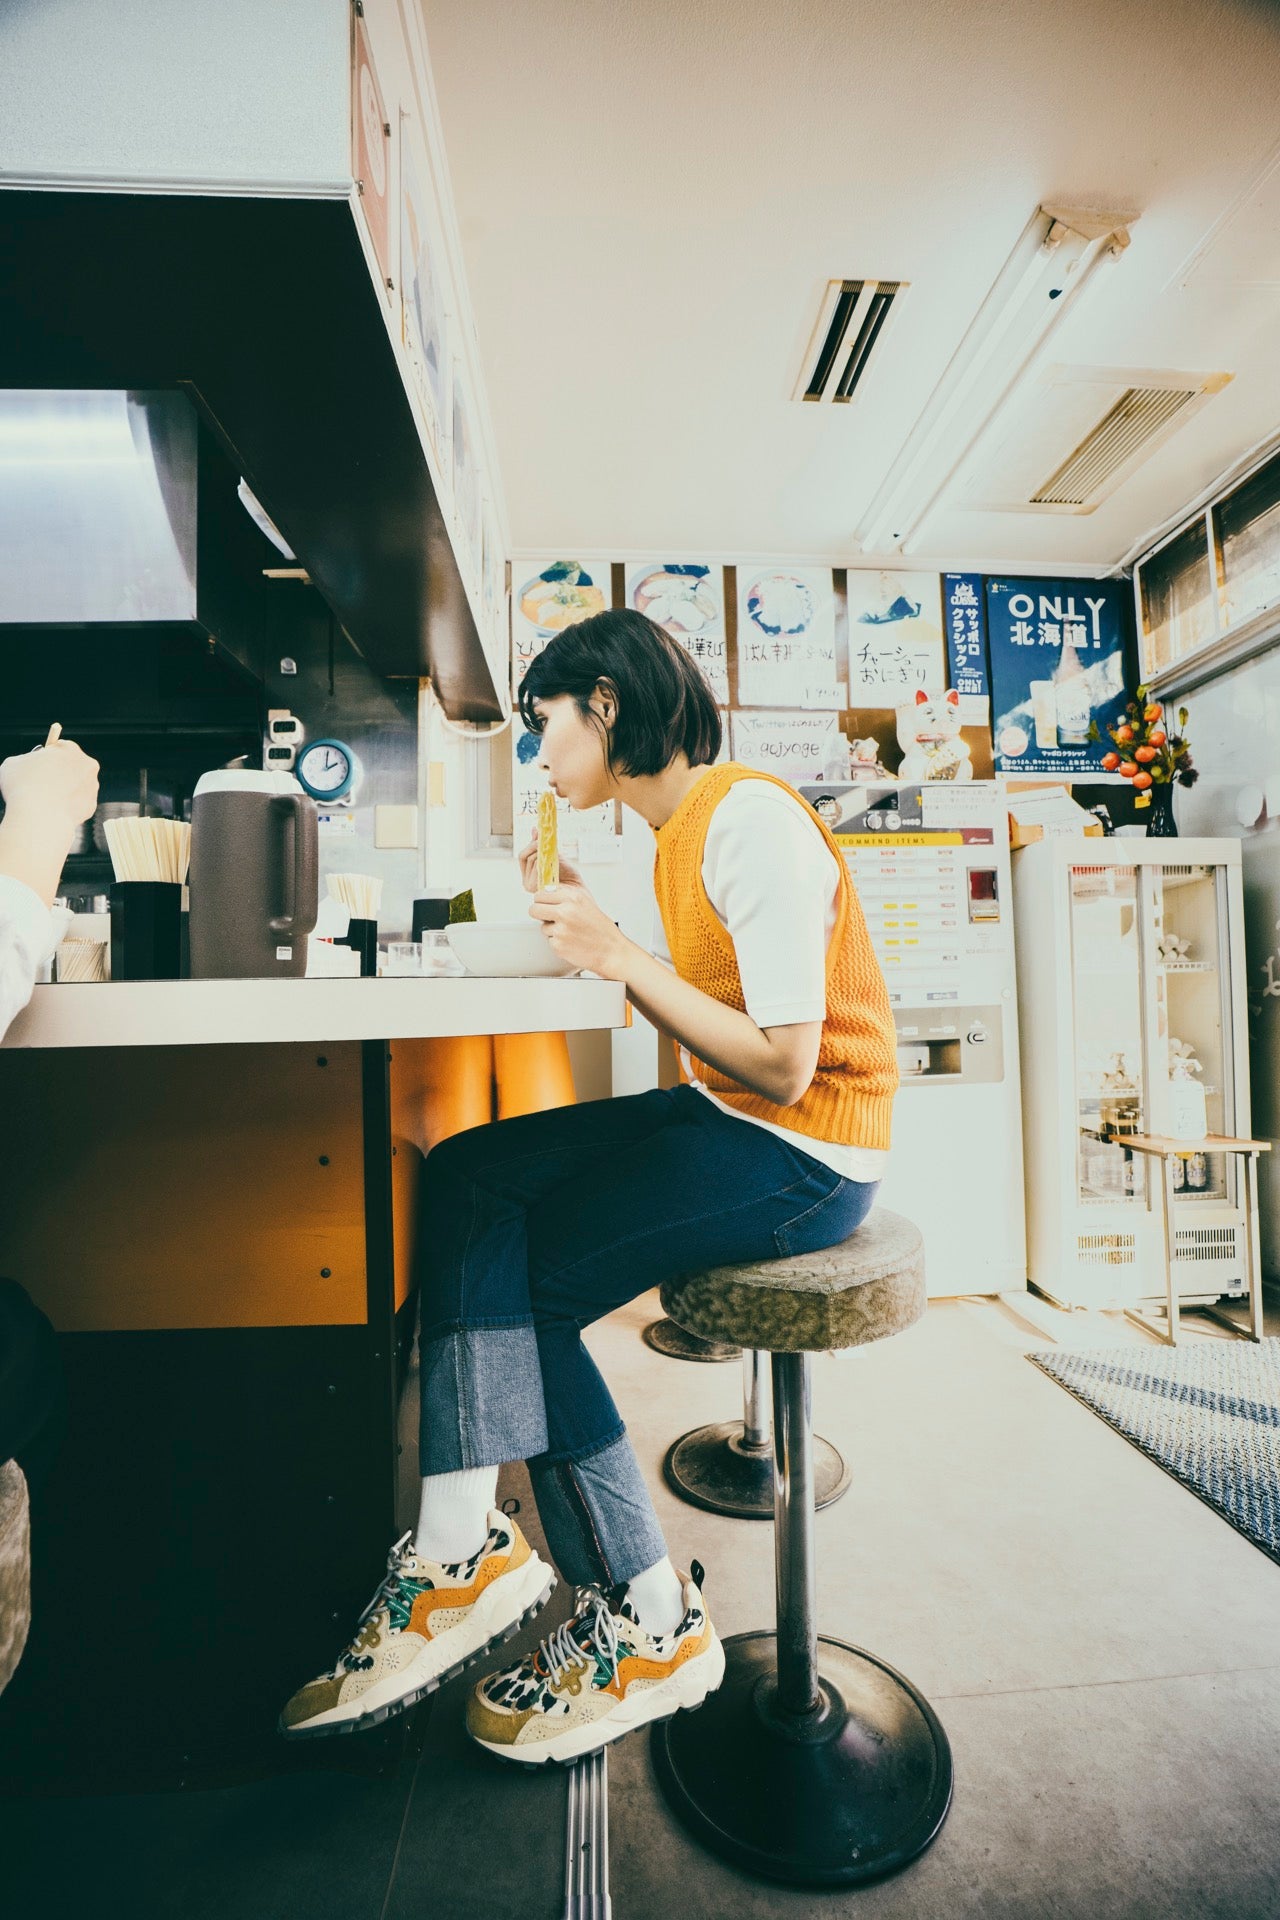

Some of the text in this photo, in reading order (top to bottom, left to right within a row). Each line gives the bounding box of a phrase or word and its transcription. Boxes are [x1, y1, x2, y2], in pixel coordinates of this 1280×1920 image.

[965, 608, 980, 656] サッポロ
[1008, 594, 1106, 639] ONLY
[856, 642, 930, 665] チャーシュー
[952, 608, 967, 667] クラシック
[859, 666, 927, 686] おにぎり
[896, 837, 926, 845] ITEMS
